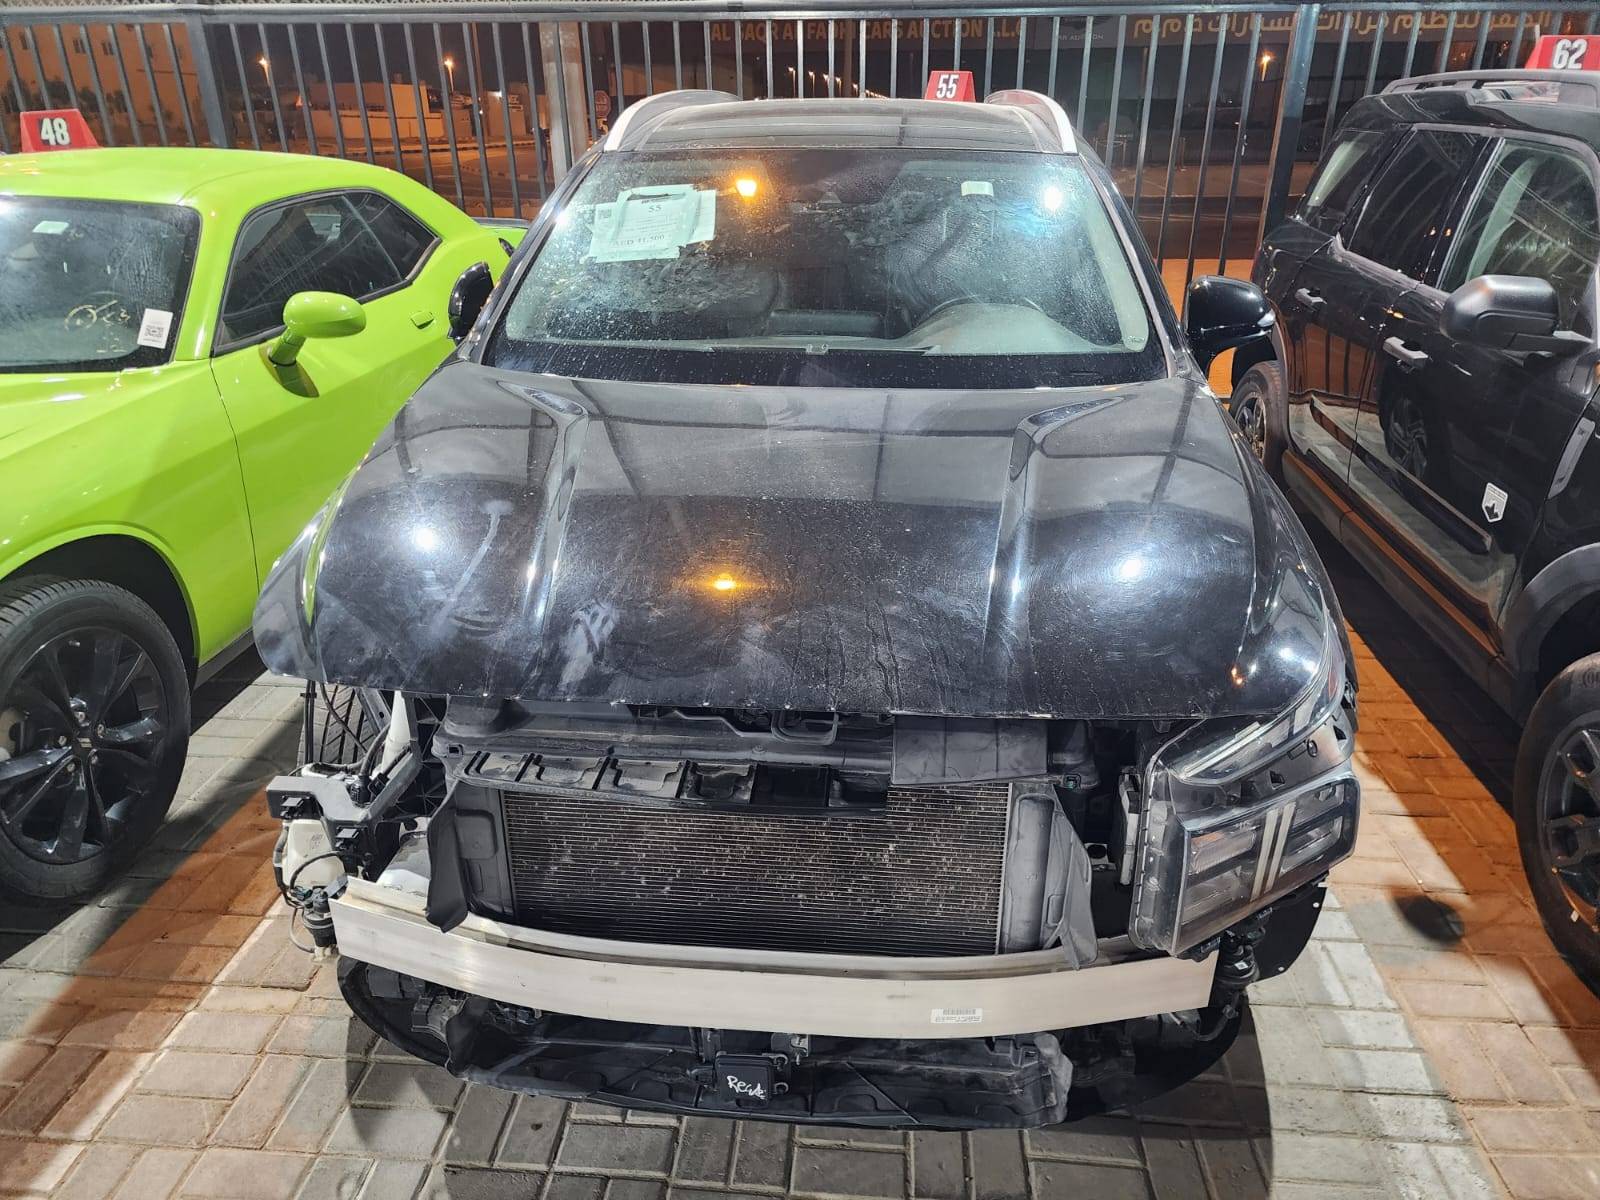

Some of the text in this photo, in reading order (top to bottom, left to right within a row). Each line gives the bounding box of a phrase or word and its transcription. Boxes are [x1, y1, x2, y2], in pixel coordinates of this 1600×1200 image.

[711, 23, 731, 41] AL
[736, 22, 779, 42] AQR
[1553, 39, 1588, 70] 62
[936, 74, 957, 99] 55
[40, 117, 70, 146] 48
